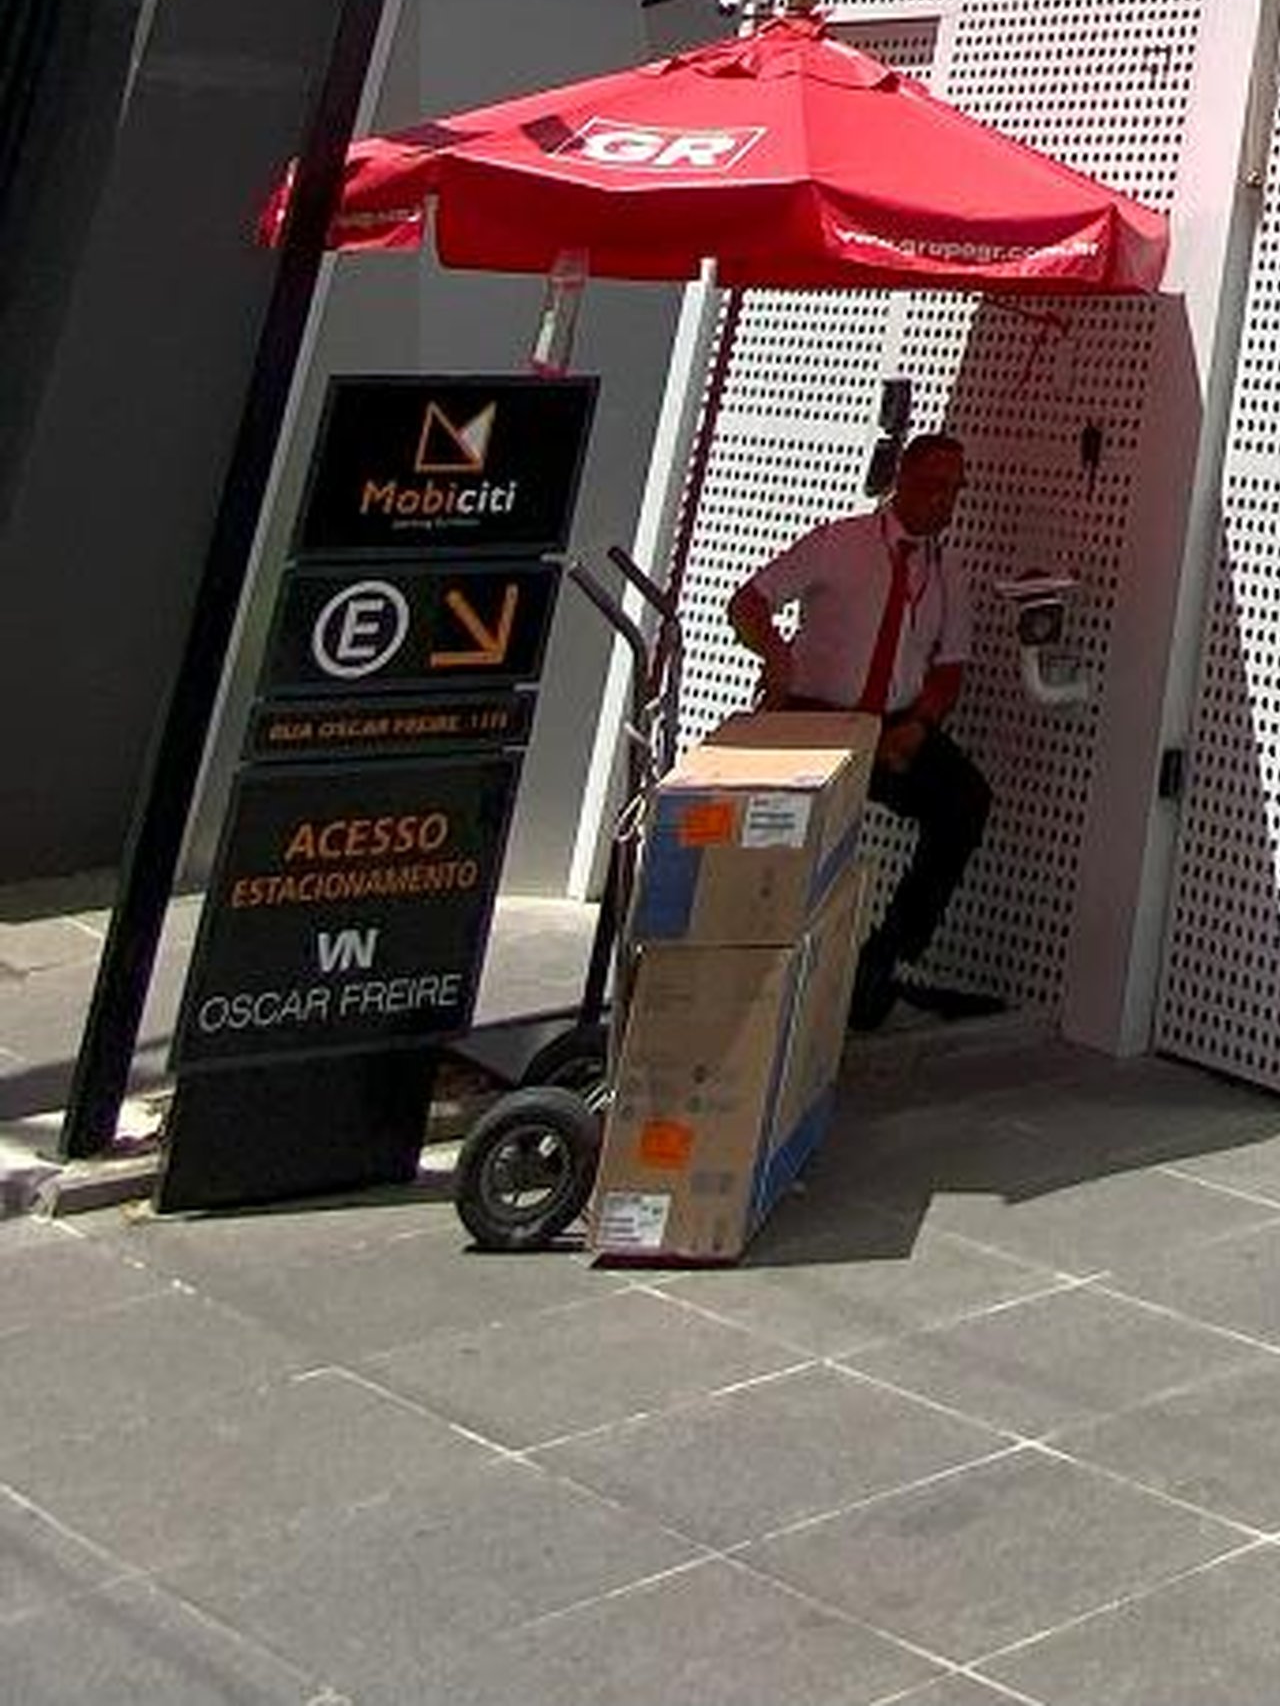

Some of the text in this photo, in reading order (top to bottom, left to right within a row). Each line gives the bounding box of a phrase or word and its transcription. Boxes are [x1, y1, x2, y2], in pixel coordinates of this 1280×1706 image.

[582, 133, 737, 166] GR
[360, 480, 518, 514] Mobiciti
[284, 813, 449, 860] ACESSO
[231, 861, 479, 908] ESTACIONAMENTO
[317, 928, 380, 973] VN
[200, 974, 463, 1032] OSCAR FREIRE
